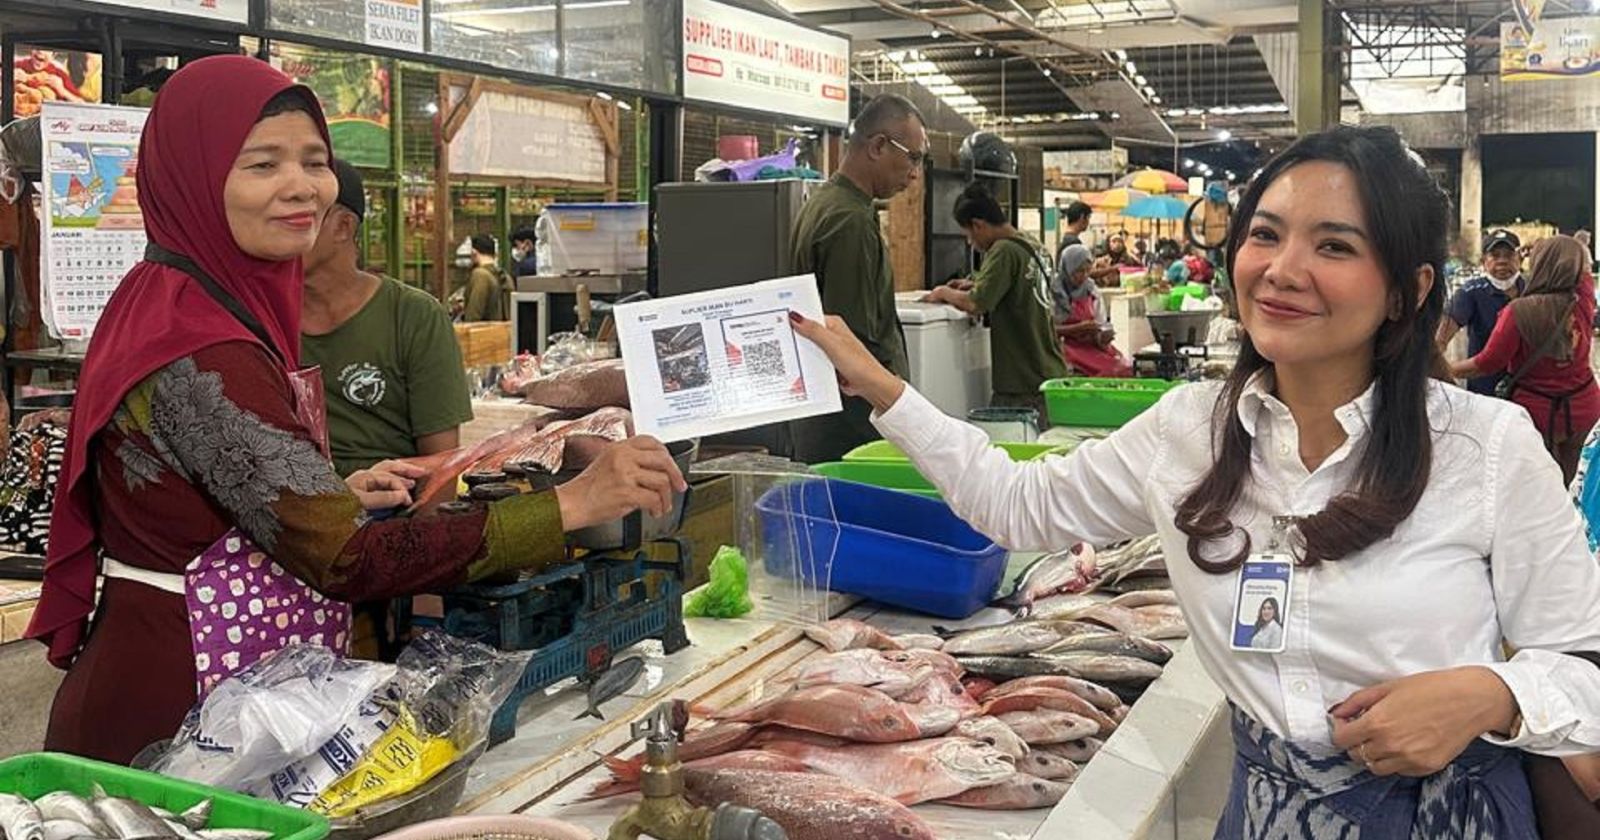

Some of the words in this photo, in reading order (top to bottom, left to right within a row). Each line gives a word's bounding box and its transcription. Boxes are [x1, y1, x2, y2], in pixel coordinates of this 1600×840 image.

[685, 17, 733, 50] SUPPLIER
[734, 31, 757, 55] IKAN
[785, 44, 815, 72] TAMBAK
